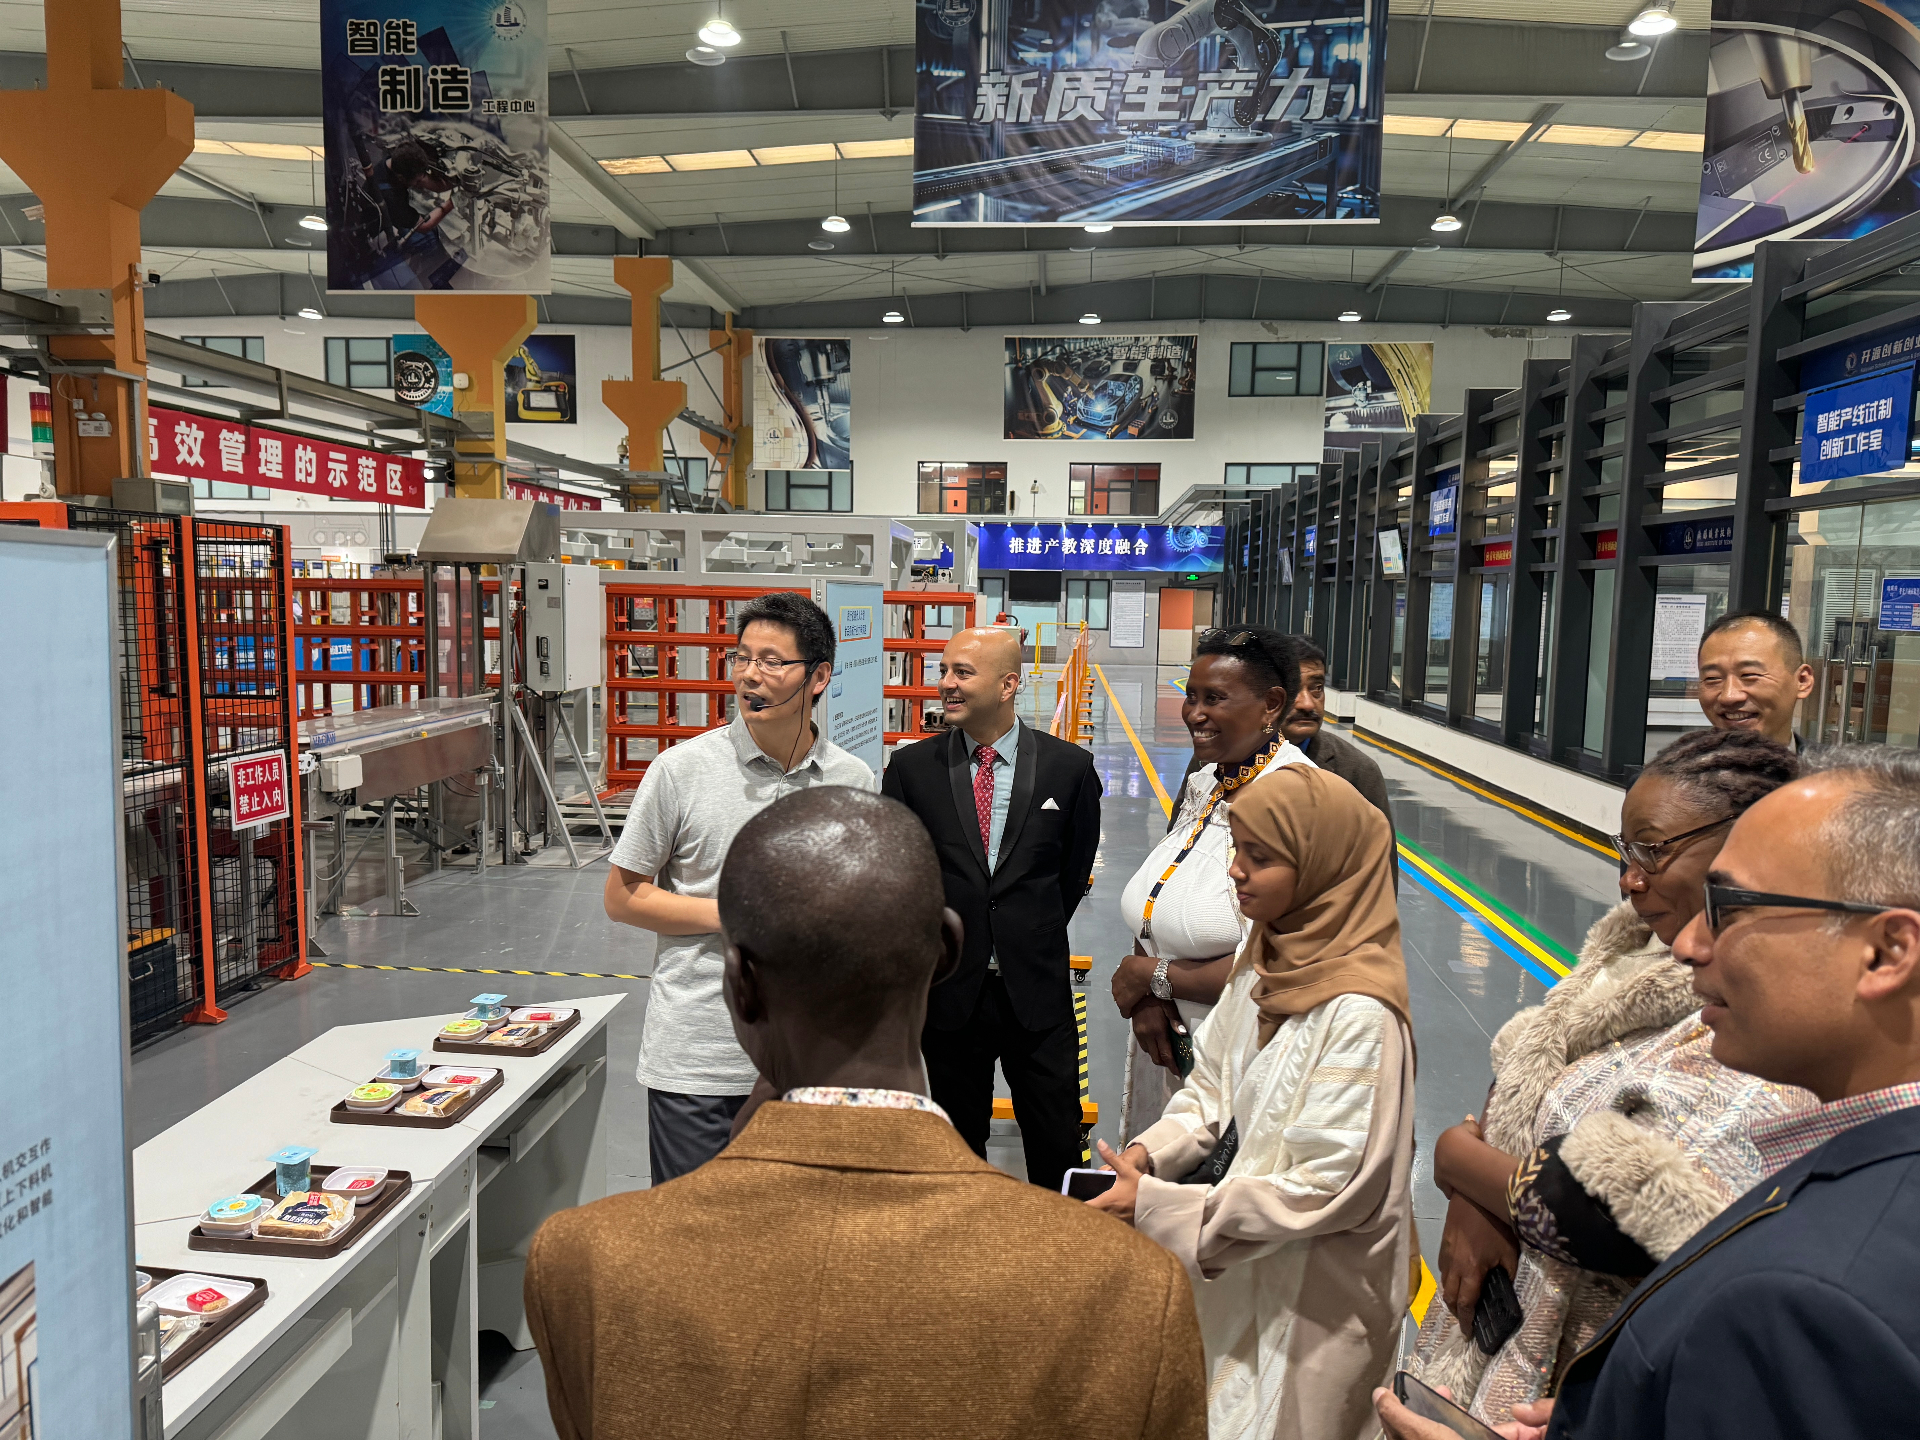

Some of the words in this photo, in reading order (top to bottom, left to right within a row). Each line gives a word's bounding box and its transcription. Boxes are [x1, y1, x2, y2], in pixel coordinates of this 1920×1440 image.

[347, 19, 417, 55] 智能
[379, 64, 471, 112] 制造
[973, 67, 1332, 123] 新质生产力
[482, 99, 535, 114] 工程中心
[1112, 345, 1182, 360] 智能制造
[1817, 397, 1893, 434] 智能产线试制
[1820, 429, 1883, 460] 创新工作室
[1008, 537, 1149, 555] 推进产教深度融合
[237, 762, 280, 788] 非工作人员
[239, 787, 282, 815] 禁止入内
[0, 1137, 51, 1182] 机交互作
[0, 1163, 52, 1211] 上下料机
[0, 1189, 52, 1237] 化和智能
